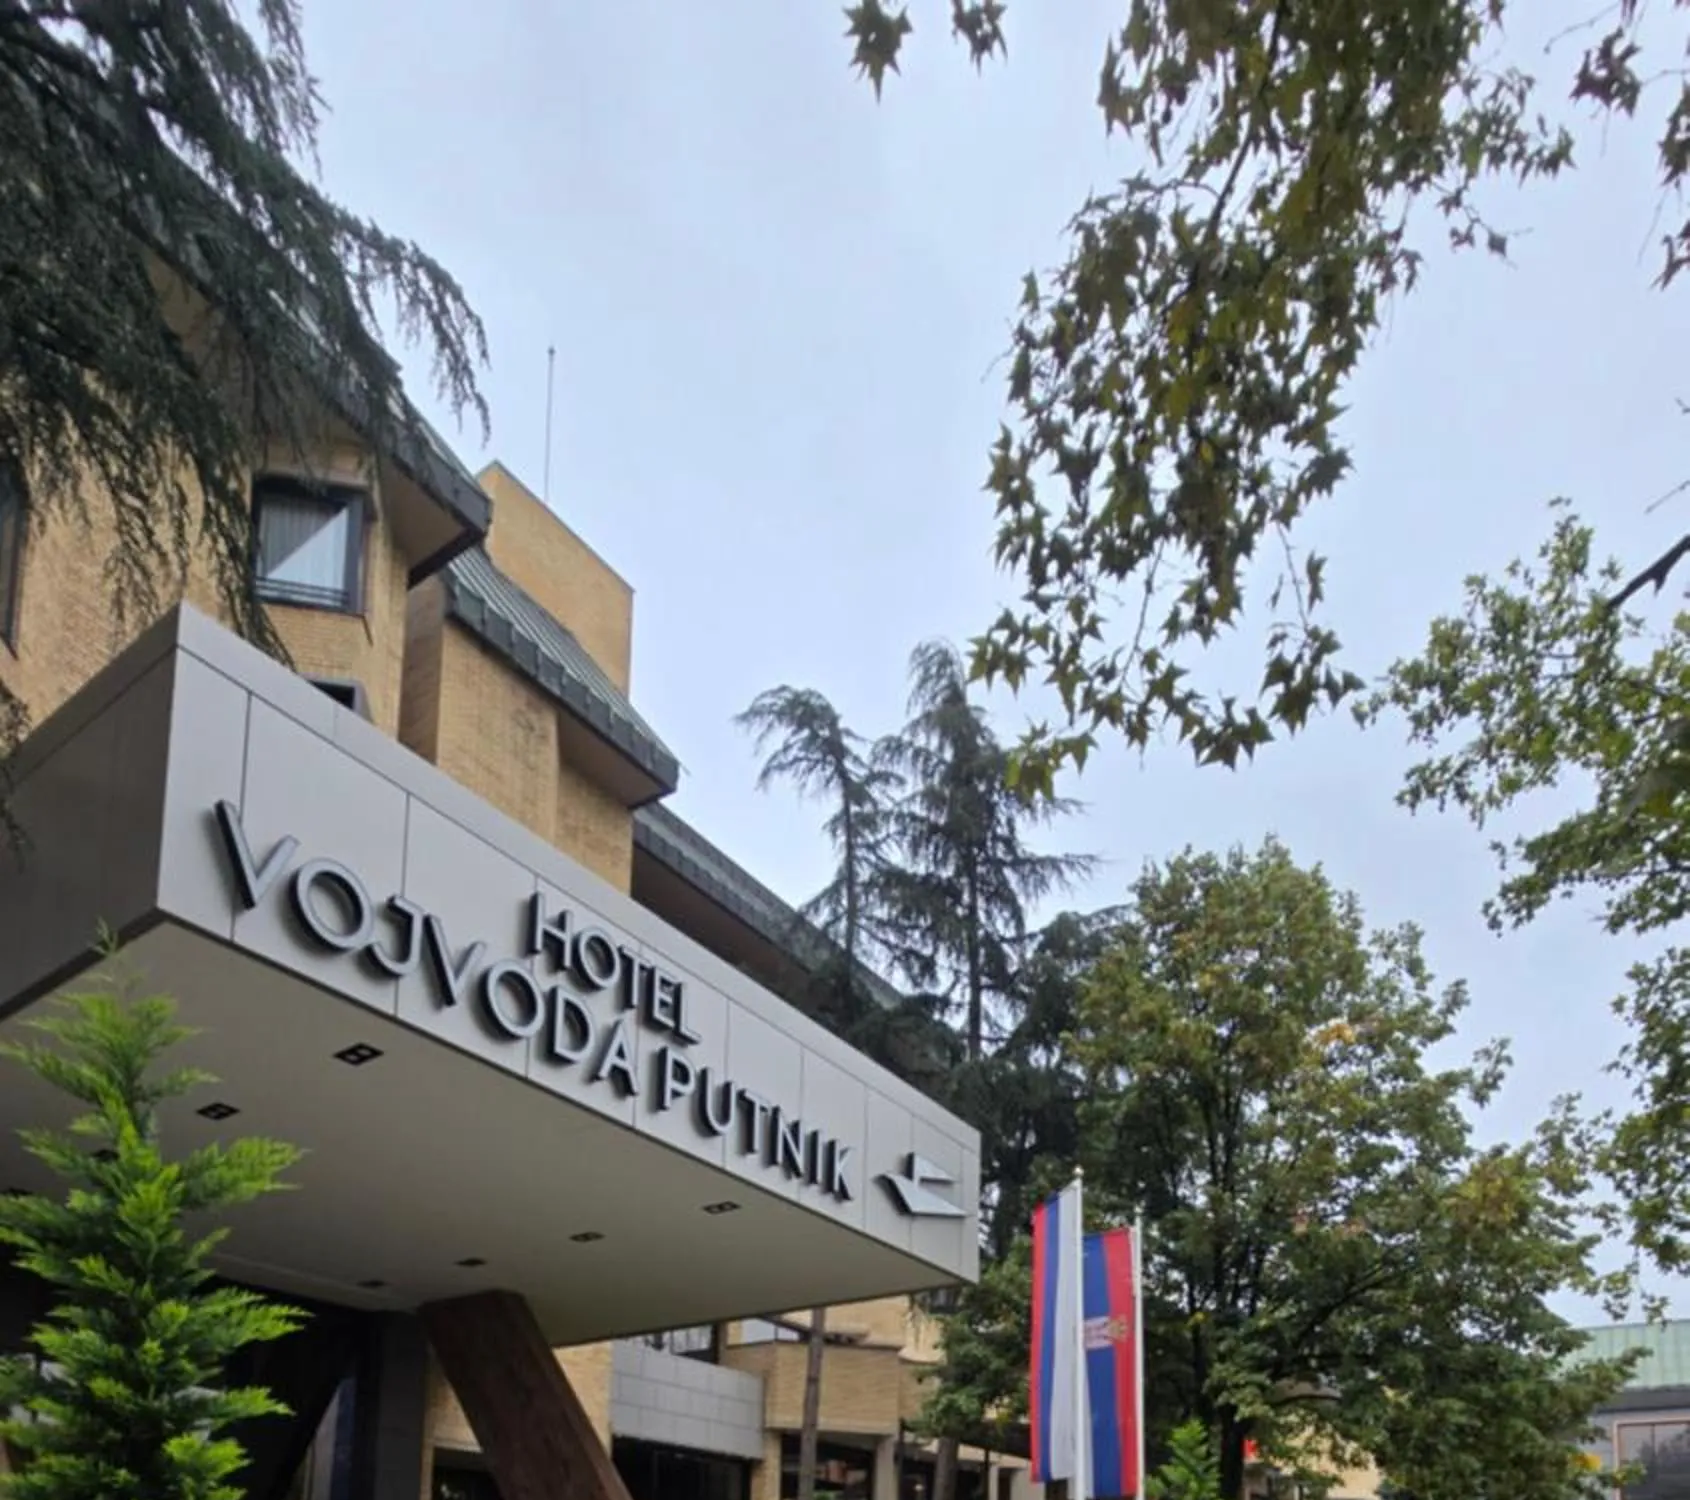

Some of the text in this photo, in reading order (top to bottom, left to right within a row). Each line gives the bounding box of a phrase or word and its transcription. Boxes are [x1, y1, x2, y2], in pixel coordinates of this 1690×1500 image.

[213, 799, 854, 1201] VOJVODA PUTNIK
[529, 891, 700, 1045] HOTEL
